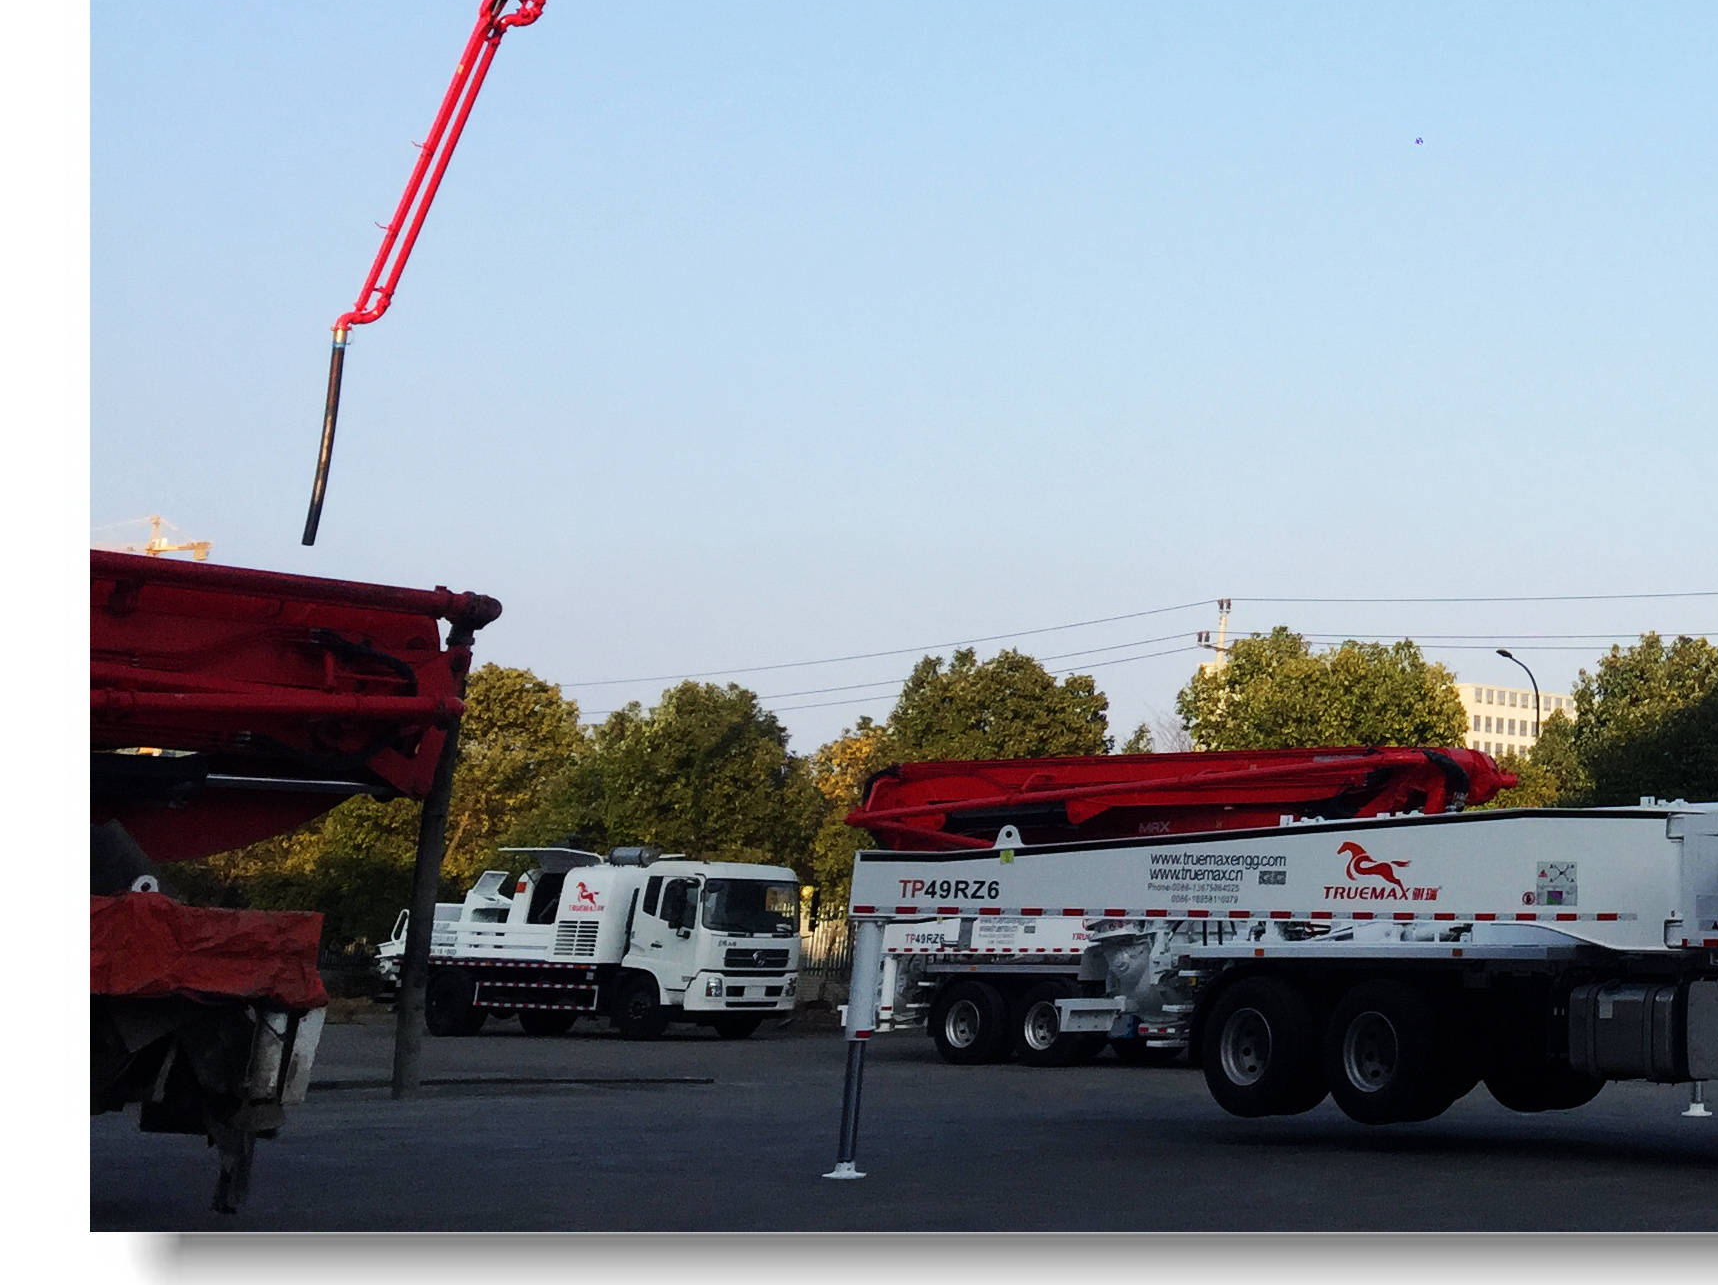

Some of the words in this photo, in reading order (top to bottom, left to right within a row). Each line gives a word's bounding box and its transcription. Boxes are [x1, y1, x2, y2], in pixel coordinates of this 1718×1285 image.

[1150, 851, 1287, 870] www.truemaxengg.com
[1149, 866, 1244, 881] www.truemax.cn
[899, 879, 1000, 899] TP49RZ6
[1323, 885, 1411, 901] TRUEMAX
